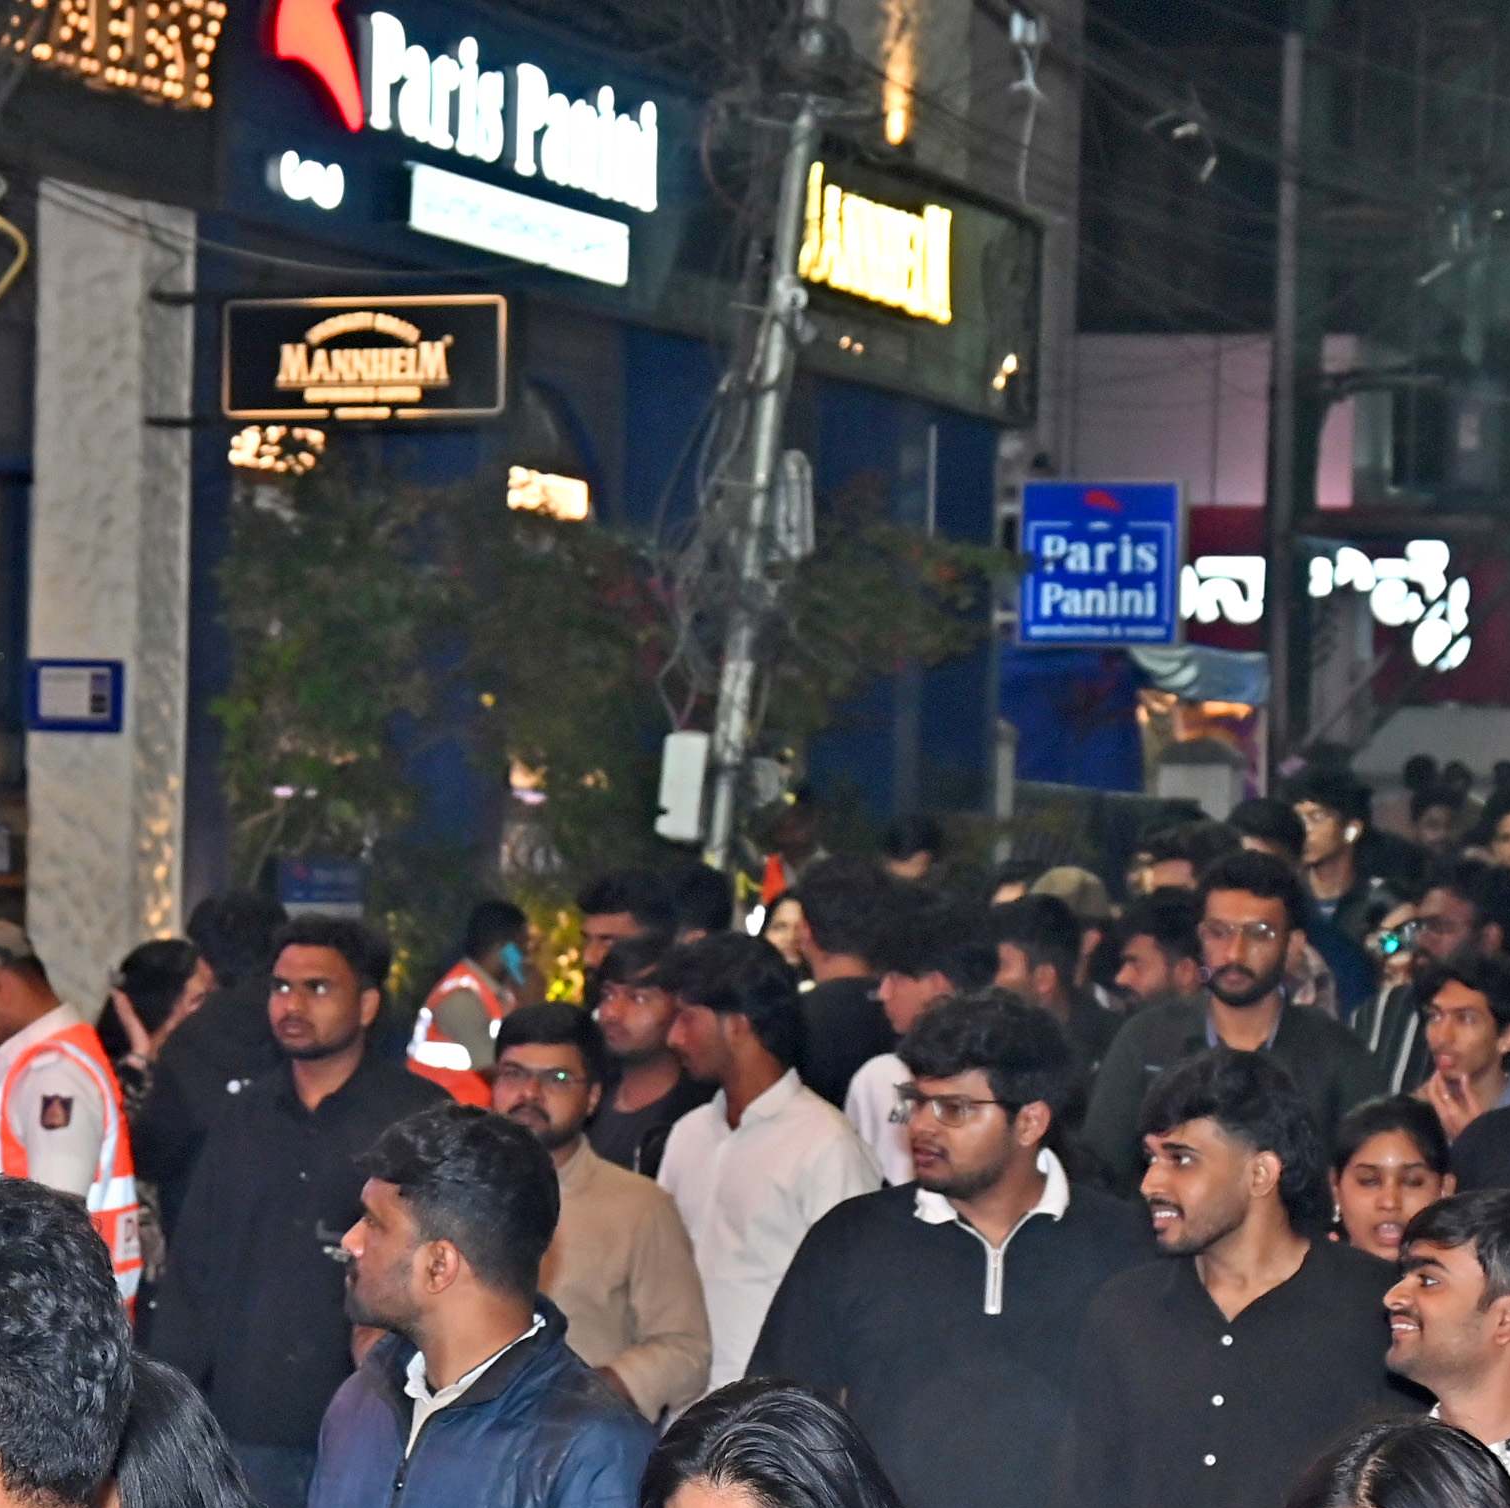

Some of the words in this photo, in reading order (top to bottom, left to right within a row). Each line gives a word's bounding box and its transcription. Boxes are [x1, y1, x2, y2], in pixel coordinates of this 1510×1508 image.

[370, 11, 504, 162] Paris
[1042, 533, 1159, 574] Paris
[1040, 581, 1157, 619] Panini
